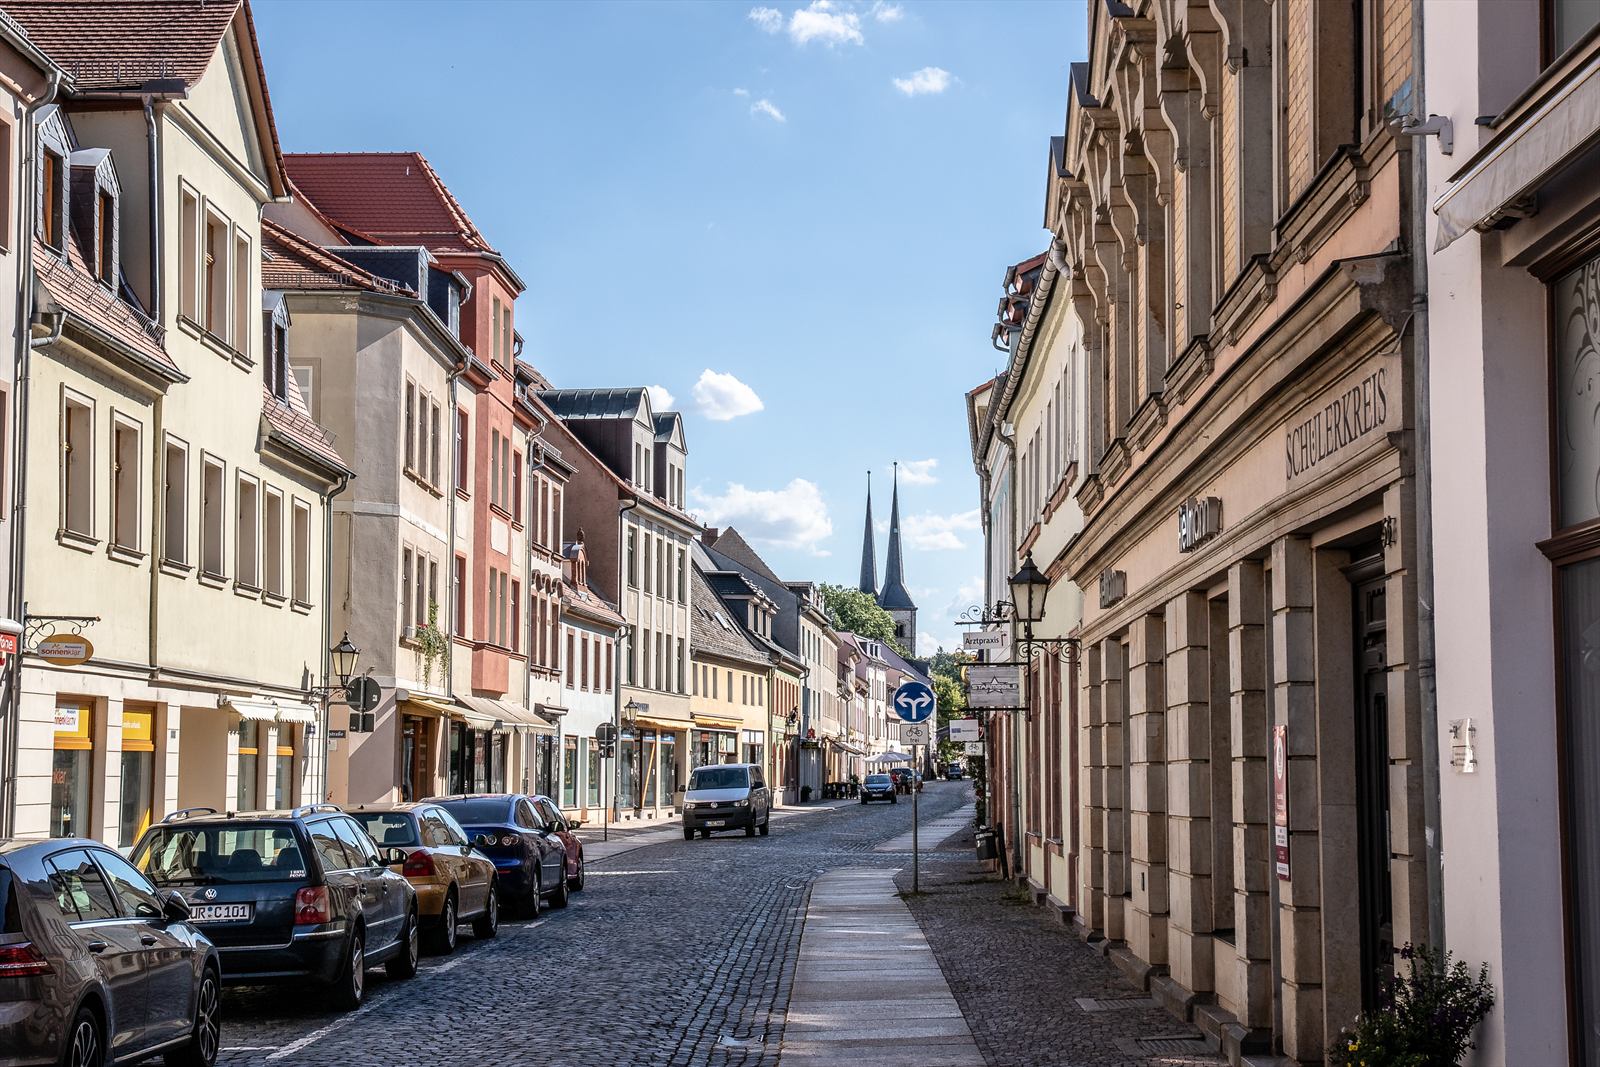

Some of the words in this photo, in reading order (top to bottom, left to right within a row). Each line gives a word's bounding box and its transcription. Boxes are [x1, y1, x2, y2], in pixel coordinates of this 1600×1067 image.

[1286, 368, 1387, 480] SCHÜLERKREIS
[965, 637, 1000, 645] Arztpraxis
[214, 906, 222, 918] C
[224, 906, 247, 918] 101
